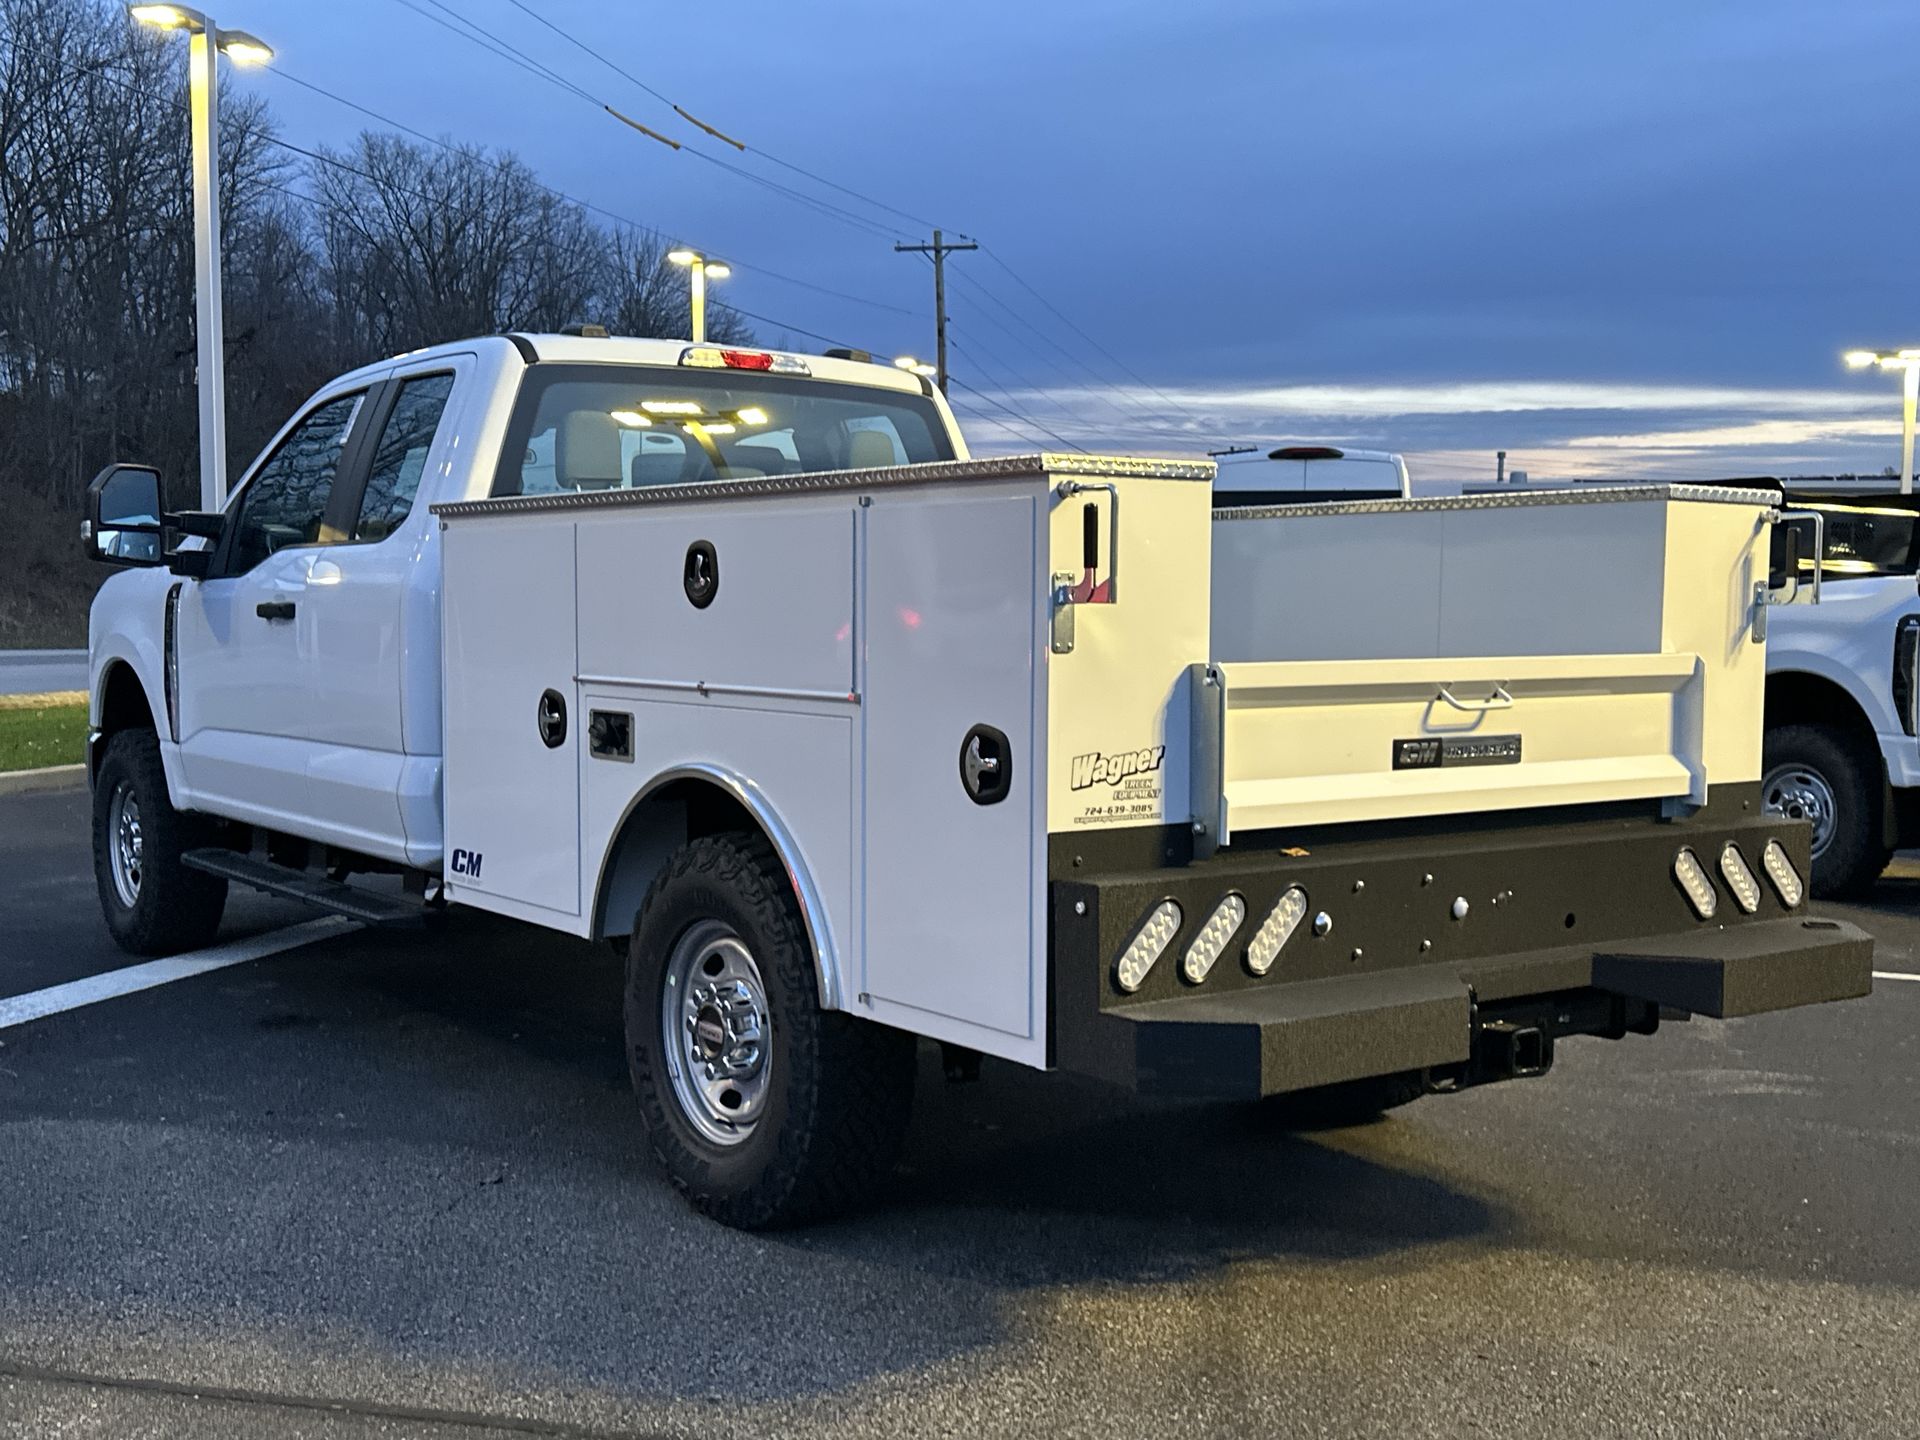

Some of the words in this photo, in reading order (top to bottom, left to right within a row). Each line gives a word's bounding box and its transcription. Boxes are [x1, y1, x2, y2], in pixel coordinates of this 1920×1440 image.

[1400, 741, 1439, 764] CM
[1071, 745, 1165, 791] Wagner
[1125, 779, 1153, 789] TRUCK
[1113, 788, 1161, 801] EQUIPMENT
[1084, 804, 1153, 816] 724-639-3085
[451, 848, 483, 878] CM
